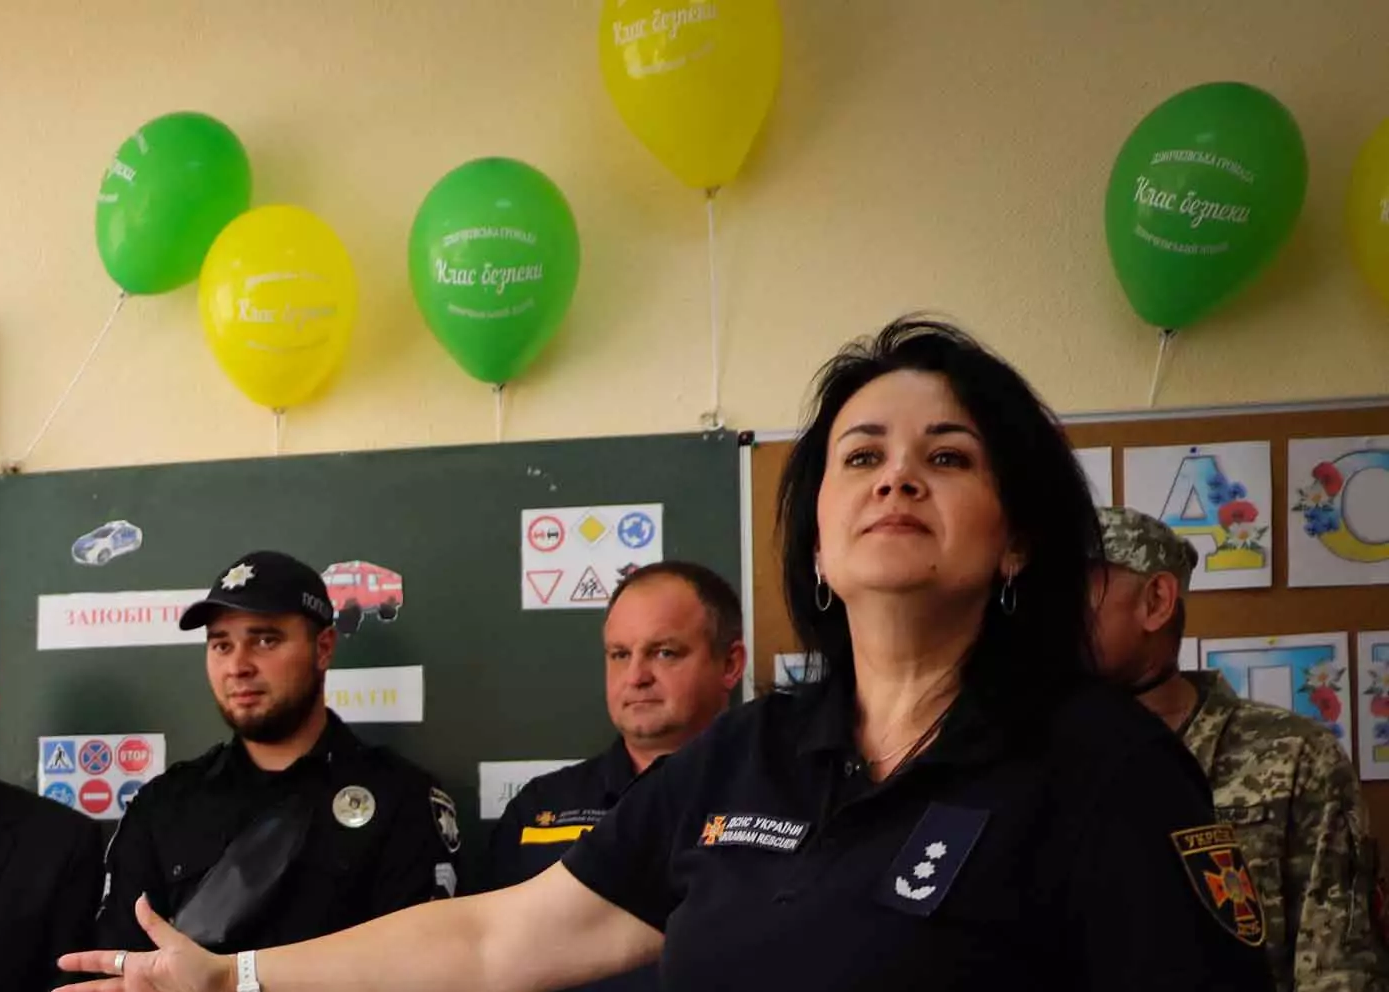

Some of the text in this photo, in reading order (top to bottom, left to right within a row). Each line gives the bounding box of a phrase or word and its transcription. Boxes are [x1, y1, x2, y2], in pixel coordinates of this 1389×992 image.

[613, 19, 648, 46] Клас
[1134, 175, 1251, 229] Клас безпеки
[435, 257, 543, 295] Клас безпеки
[325, 686, 398, 708] ВАТИ
[121, 750, 148, 762] STOP
[726, 816, 804, 837] ДСНС УКРАЇНИ
[756, 832, 798, 850] RESCUER
